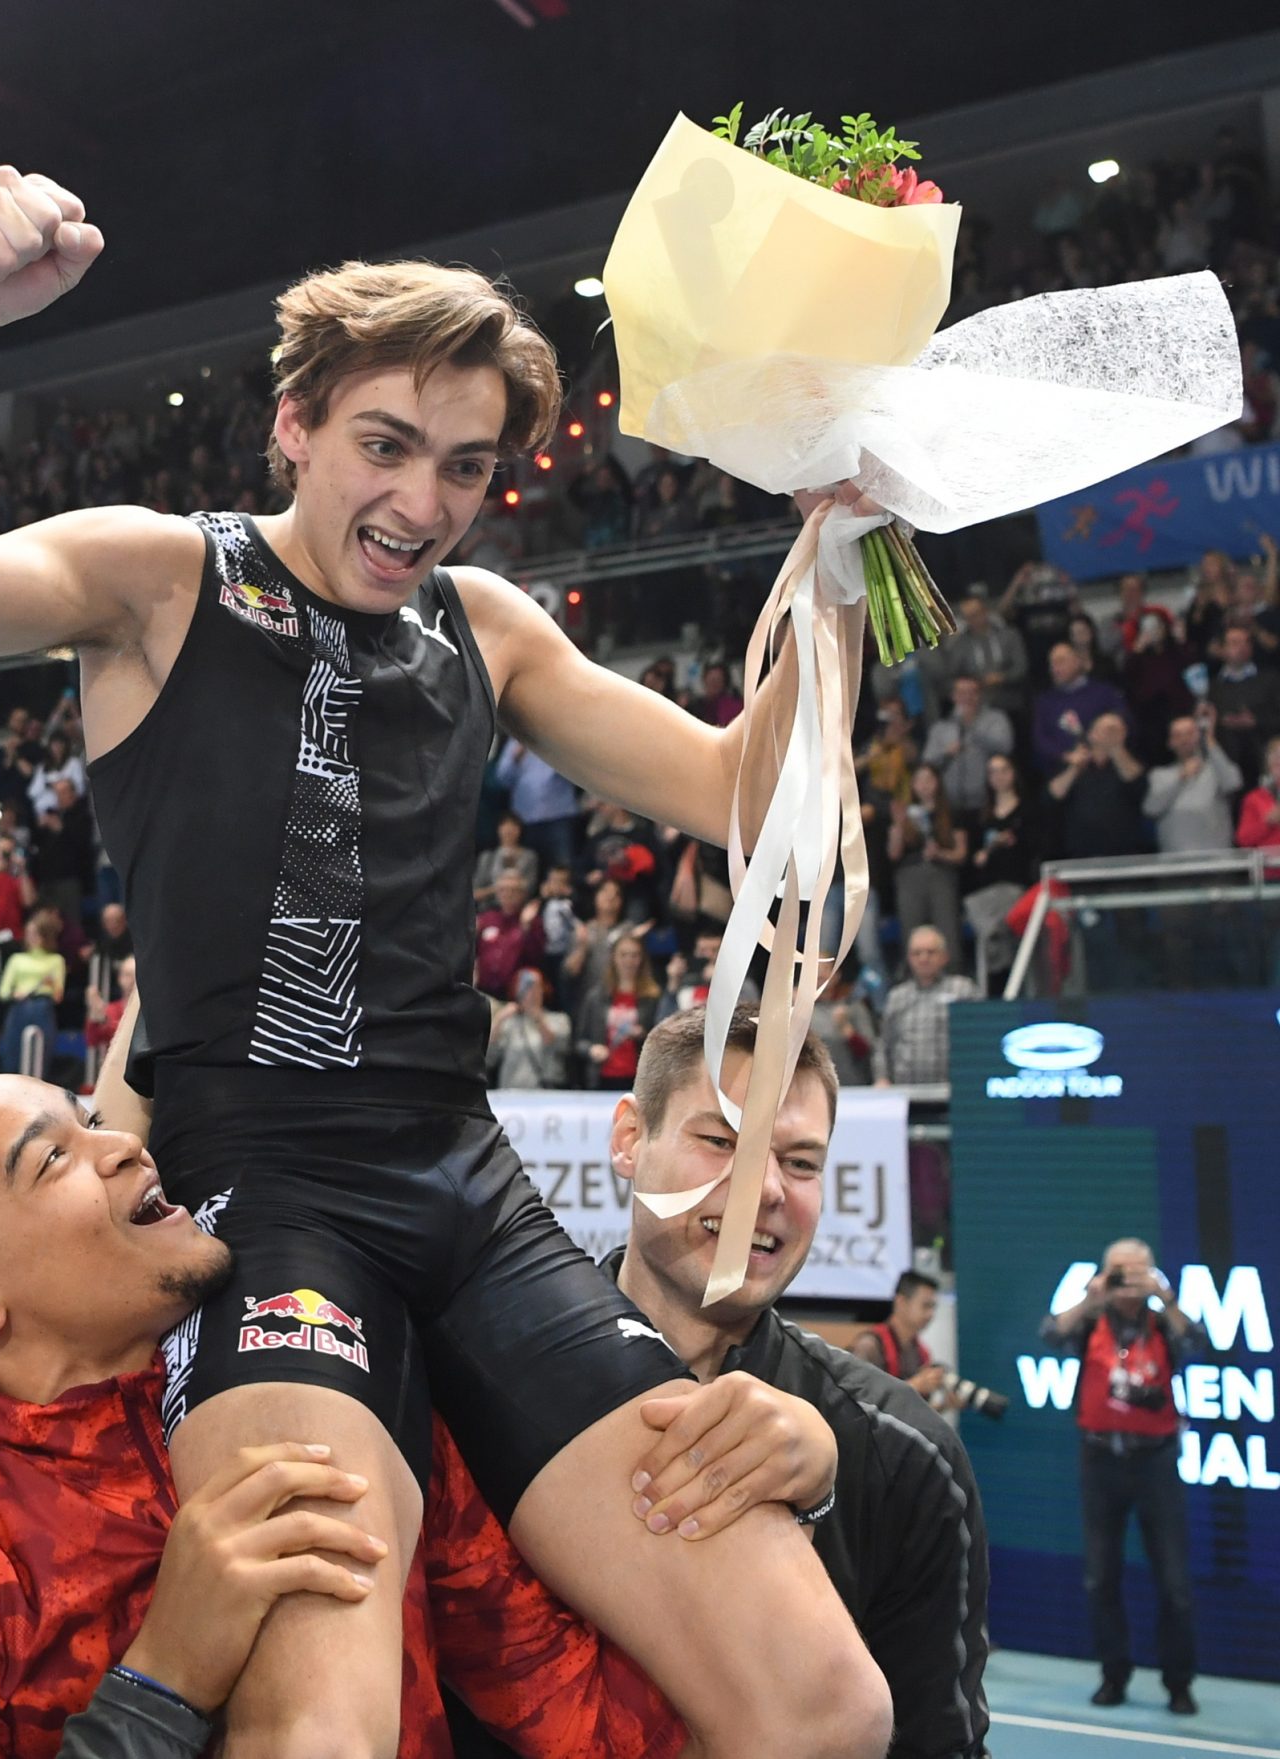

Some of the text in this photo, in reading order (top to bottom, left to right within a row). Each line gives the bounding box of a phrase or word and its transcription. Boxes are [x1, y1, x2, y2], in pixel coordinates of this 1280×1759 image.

[219, 585, 299, 638] Red Bull
[238, 1324, 370, 1373] Red Bull
